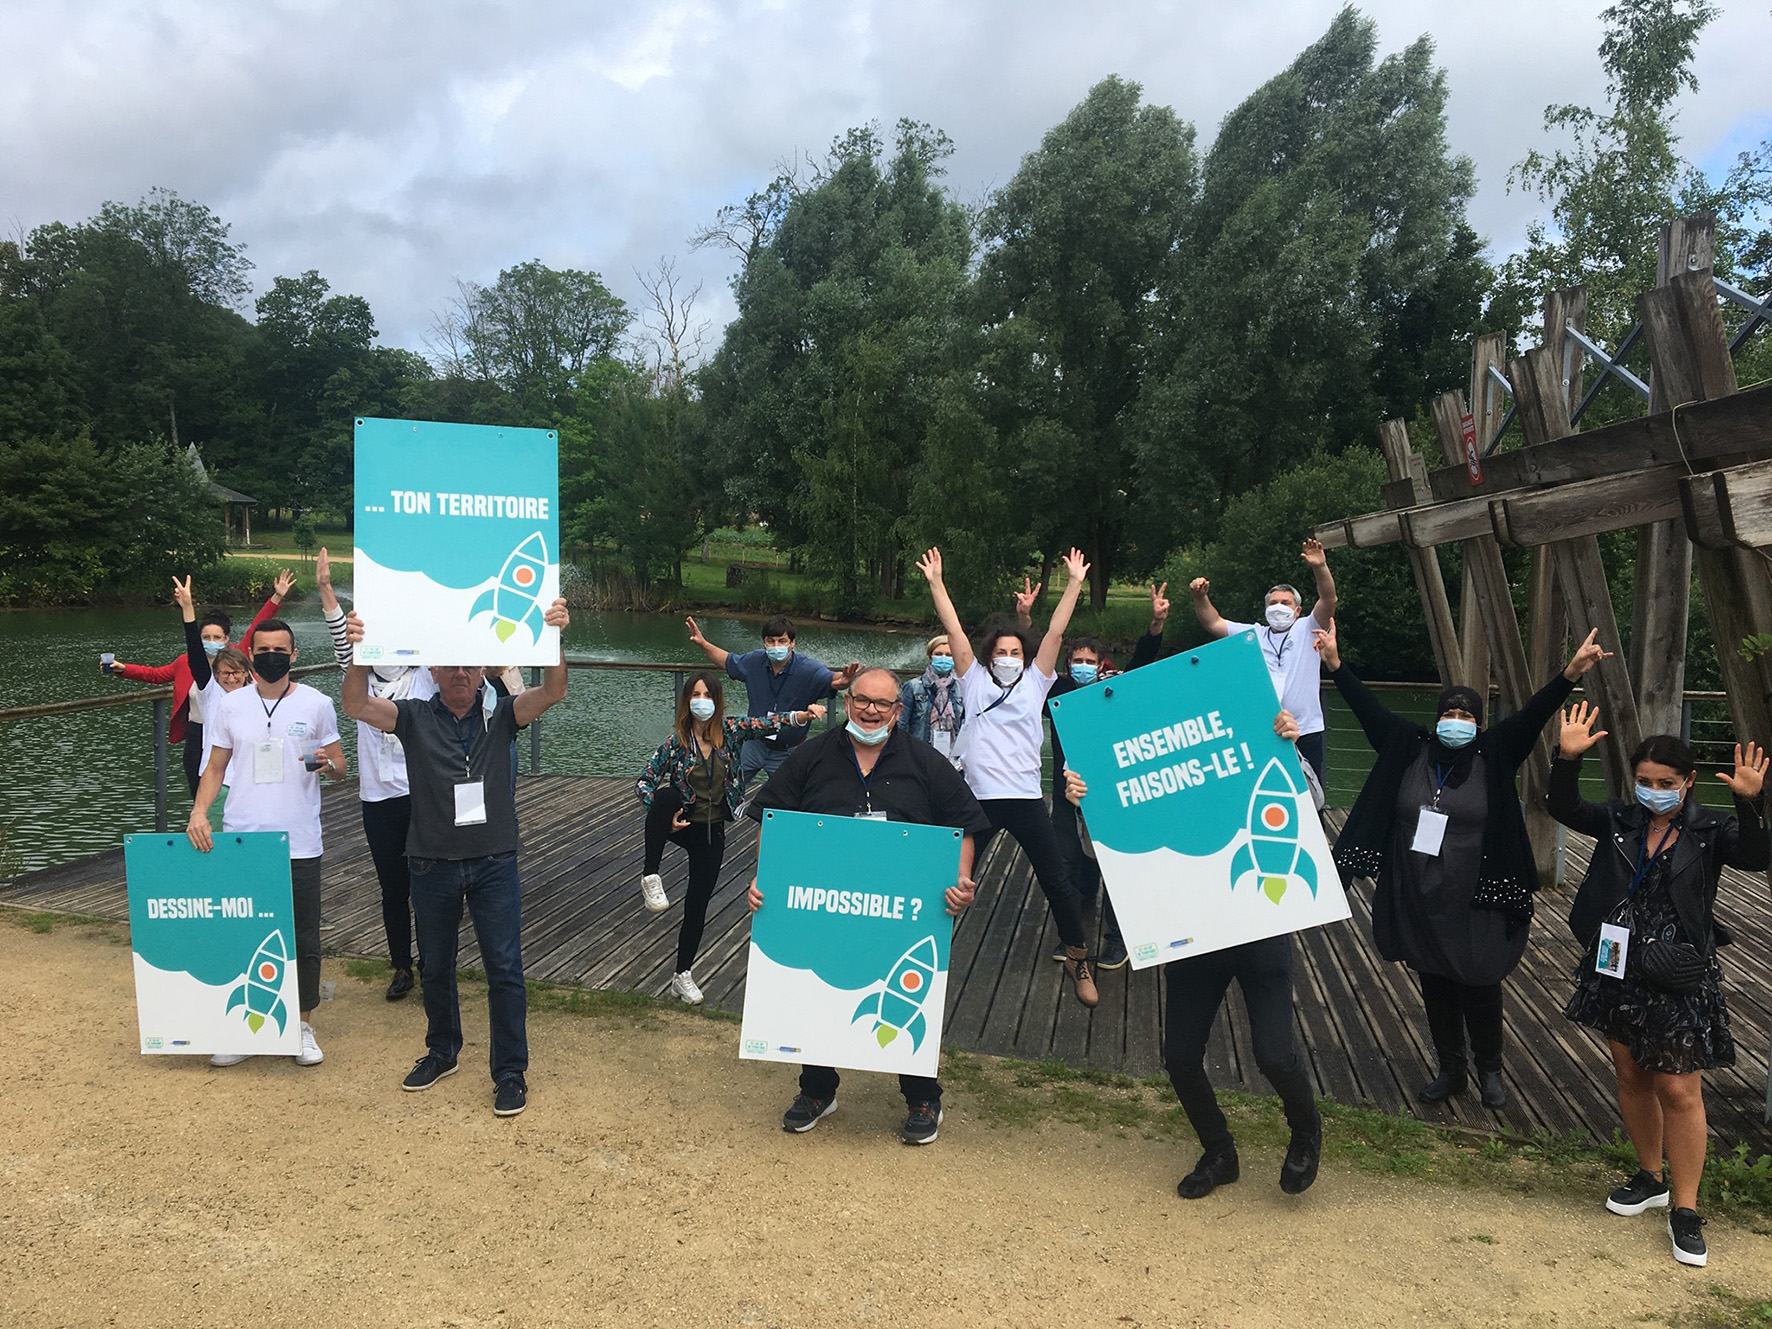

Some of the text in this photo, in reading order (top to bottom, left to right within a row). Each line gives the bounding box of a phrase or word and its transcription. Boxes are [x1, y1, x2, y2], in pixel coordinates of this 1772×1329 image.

[390, 490, 431, 515] TON
[436, 492, 549, 520] TERRITOIRE
[1112, 710, 1233, 769] ENSEMBLE,
[1116, 742, 1254, 808] FAISONS-LE !
[147, 897, 254, 919] DESSINE-MOI
[787, 885, 923, 922] IMPOSSIBLE ?
